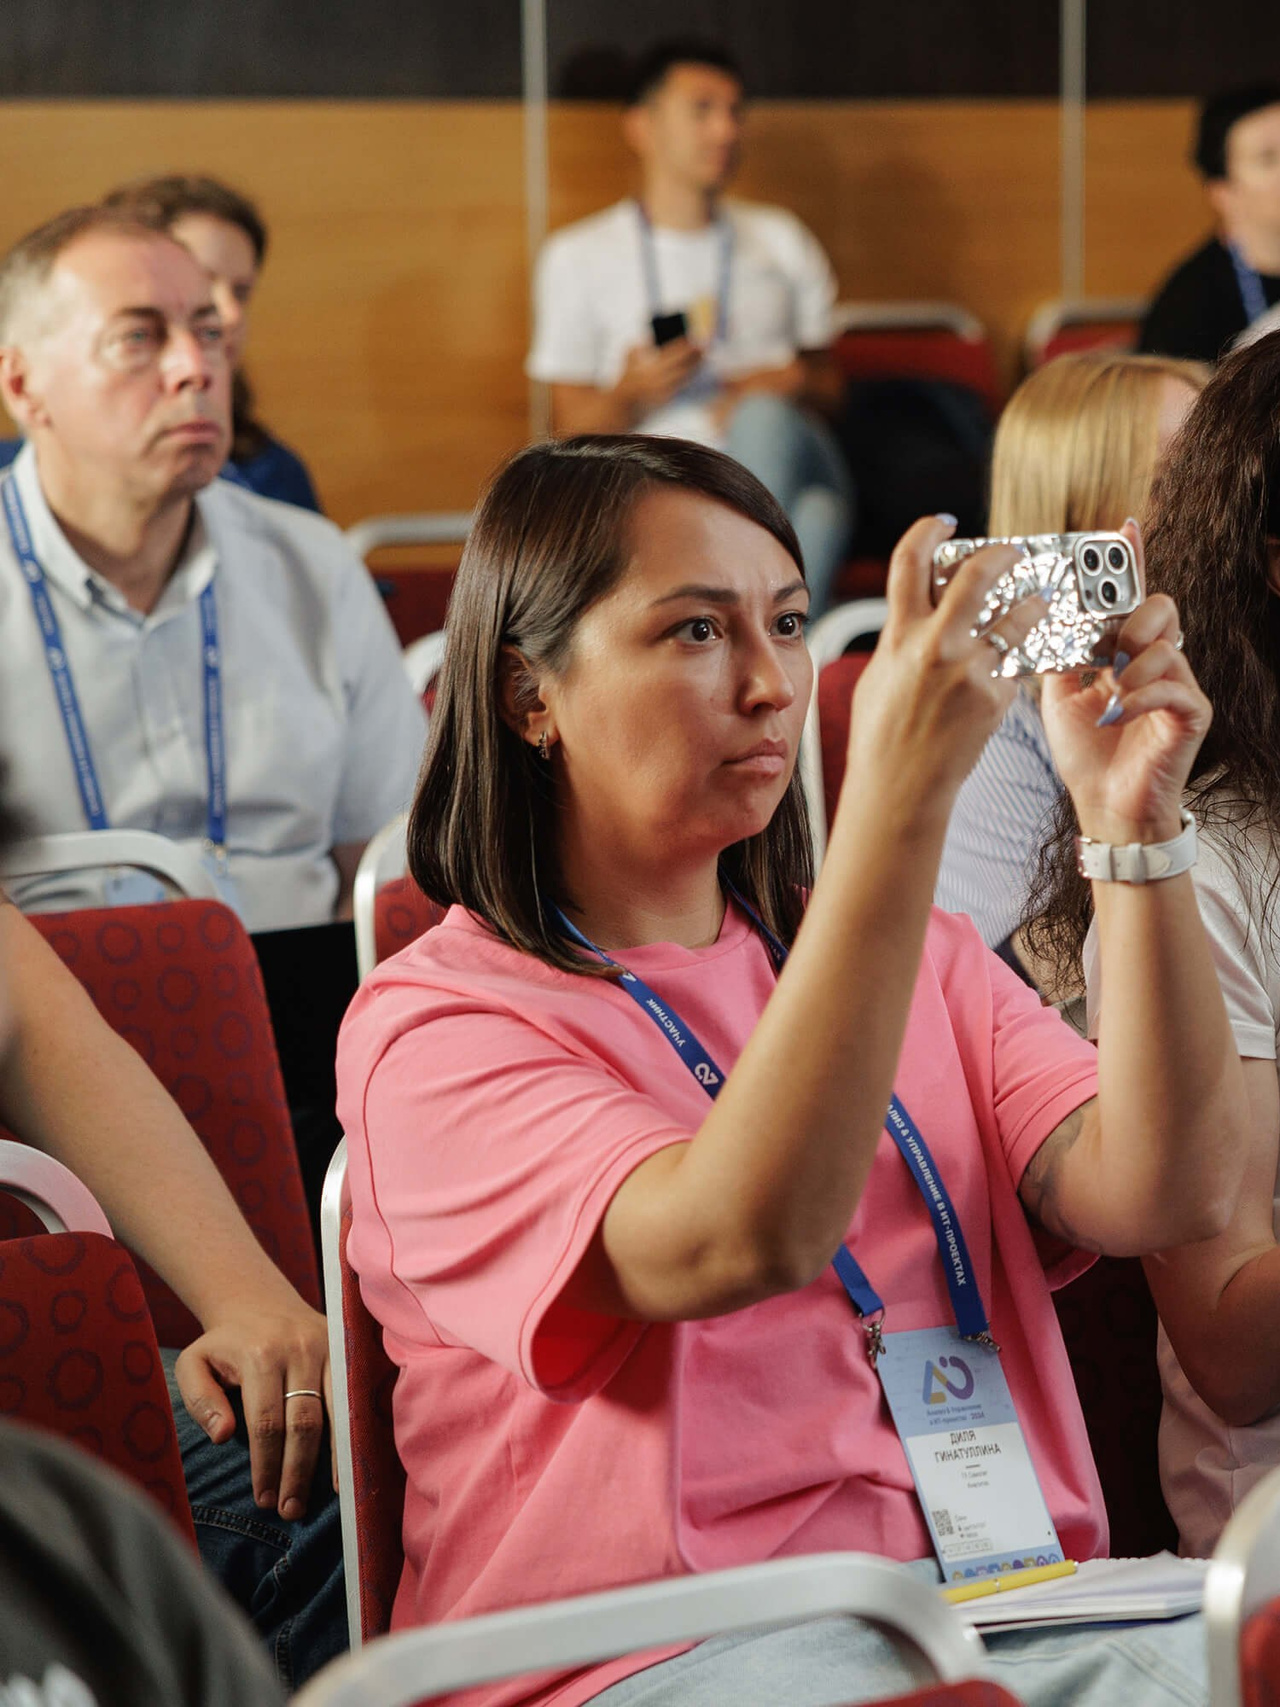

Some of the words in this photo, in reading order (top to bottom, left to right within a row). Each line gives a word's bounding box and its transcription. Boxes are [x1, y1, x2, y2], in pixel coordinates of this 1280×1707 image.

[646, 998, 686, 1048] УЧАСТНИК
[905, 1136, 943, 1203] УПРАВЛЕНИЕ
[936, 1201, 946, 1211] В
[940, 1210, 967, 1287] ИТ-ПРОЕКТАХ
[934, 1443, 1002, 1463] ГИНАТУЛЛИНА
[950, 1429, 977, 1446] ДИЛЯ
